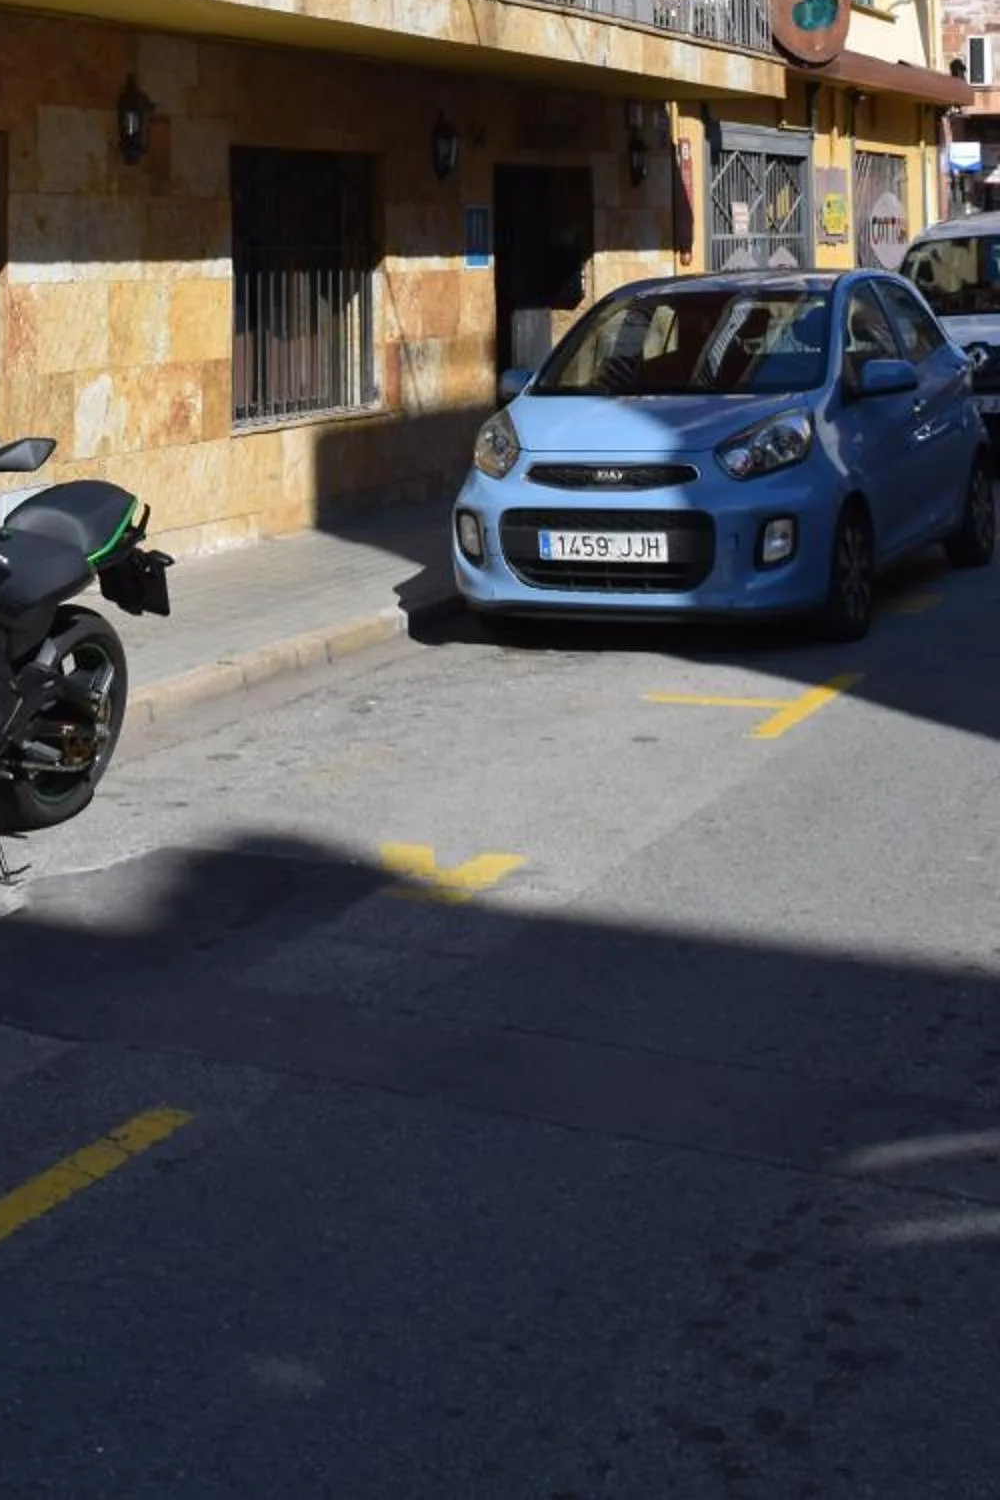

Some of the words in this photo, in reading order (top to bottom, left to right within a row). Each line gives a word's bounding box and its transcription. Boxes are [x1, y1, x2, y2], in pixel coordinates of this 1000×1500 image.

[595, 469, 623, 481] KIA
[559, 536, 609, 557] 1459
[621, 536, 660, 558] JJH
